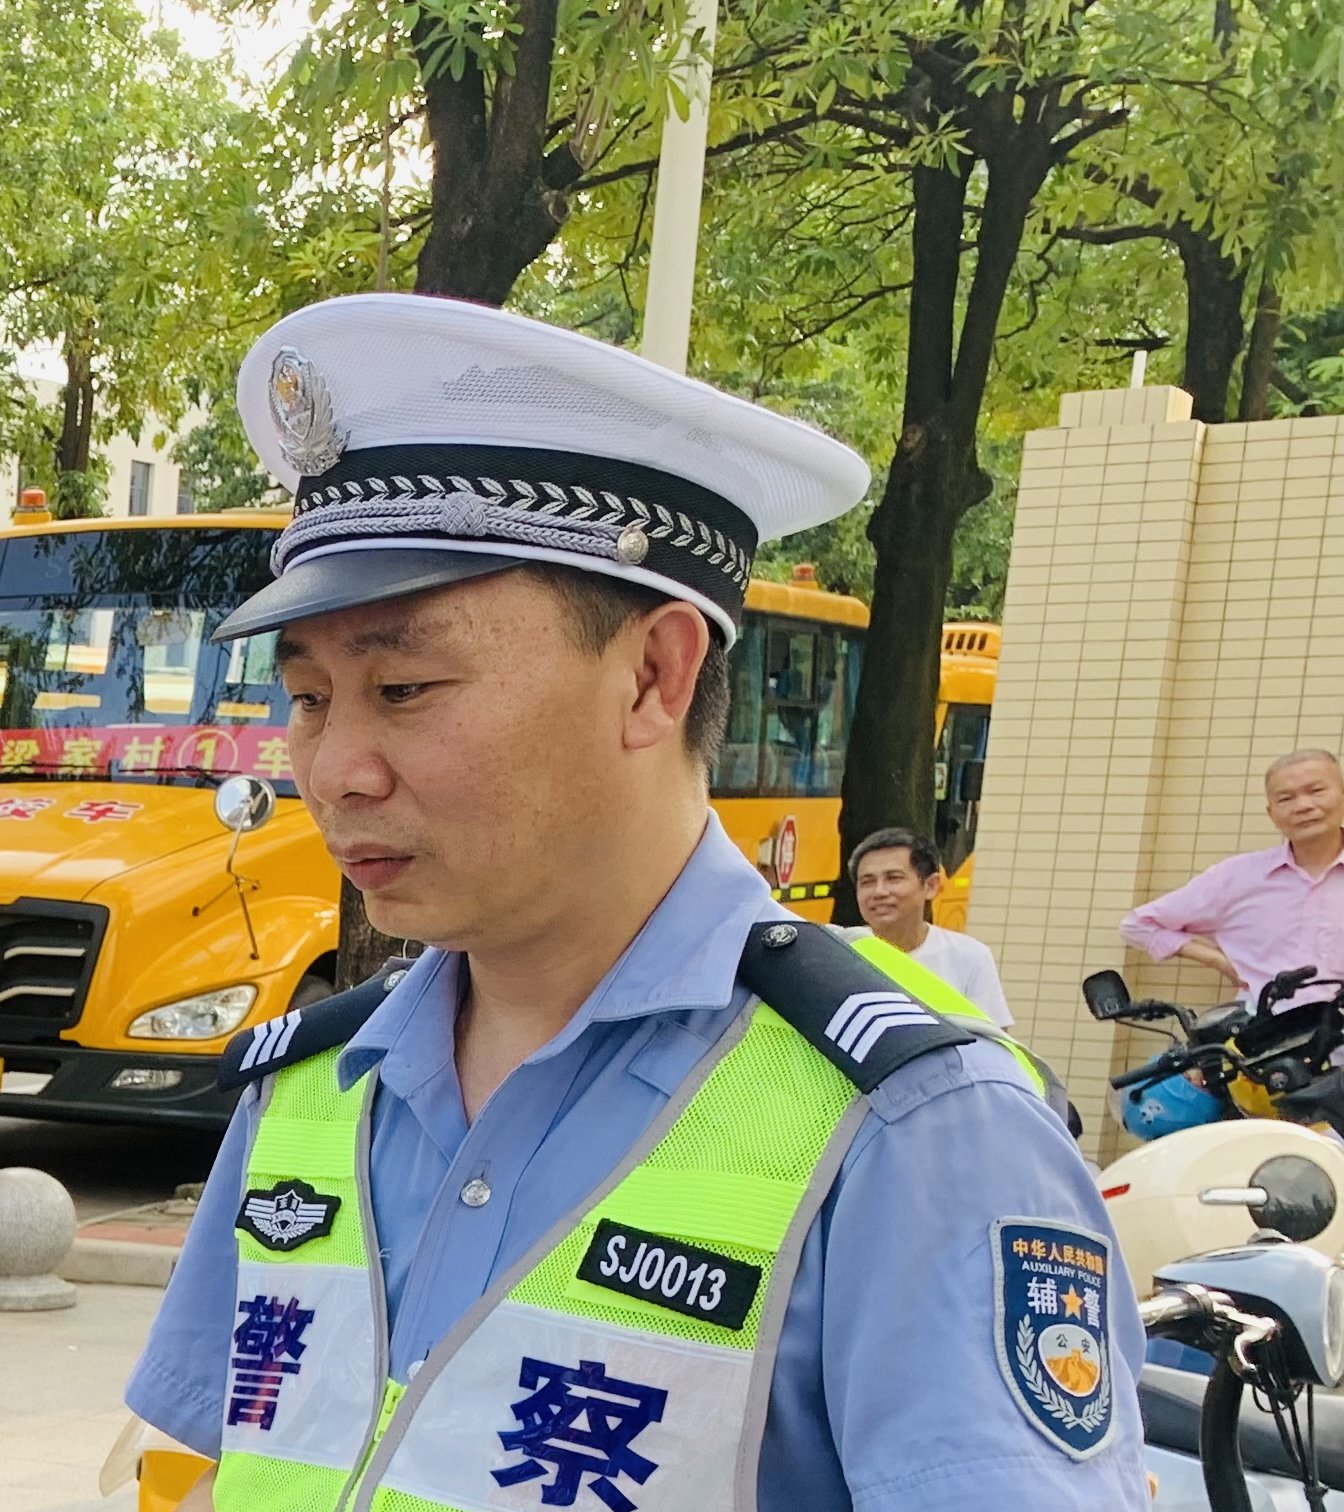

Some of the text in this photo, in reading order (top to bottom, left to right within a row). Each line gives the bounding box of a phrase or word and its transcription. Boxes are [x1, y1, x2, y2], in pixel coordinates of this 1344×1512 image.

[599, 1234, 728, 1310] SJ0013
[1022, 1260, 1102, 1288] AUXILIARY POLICE
